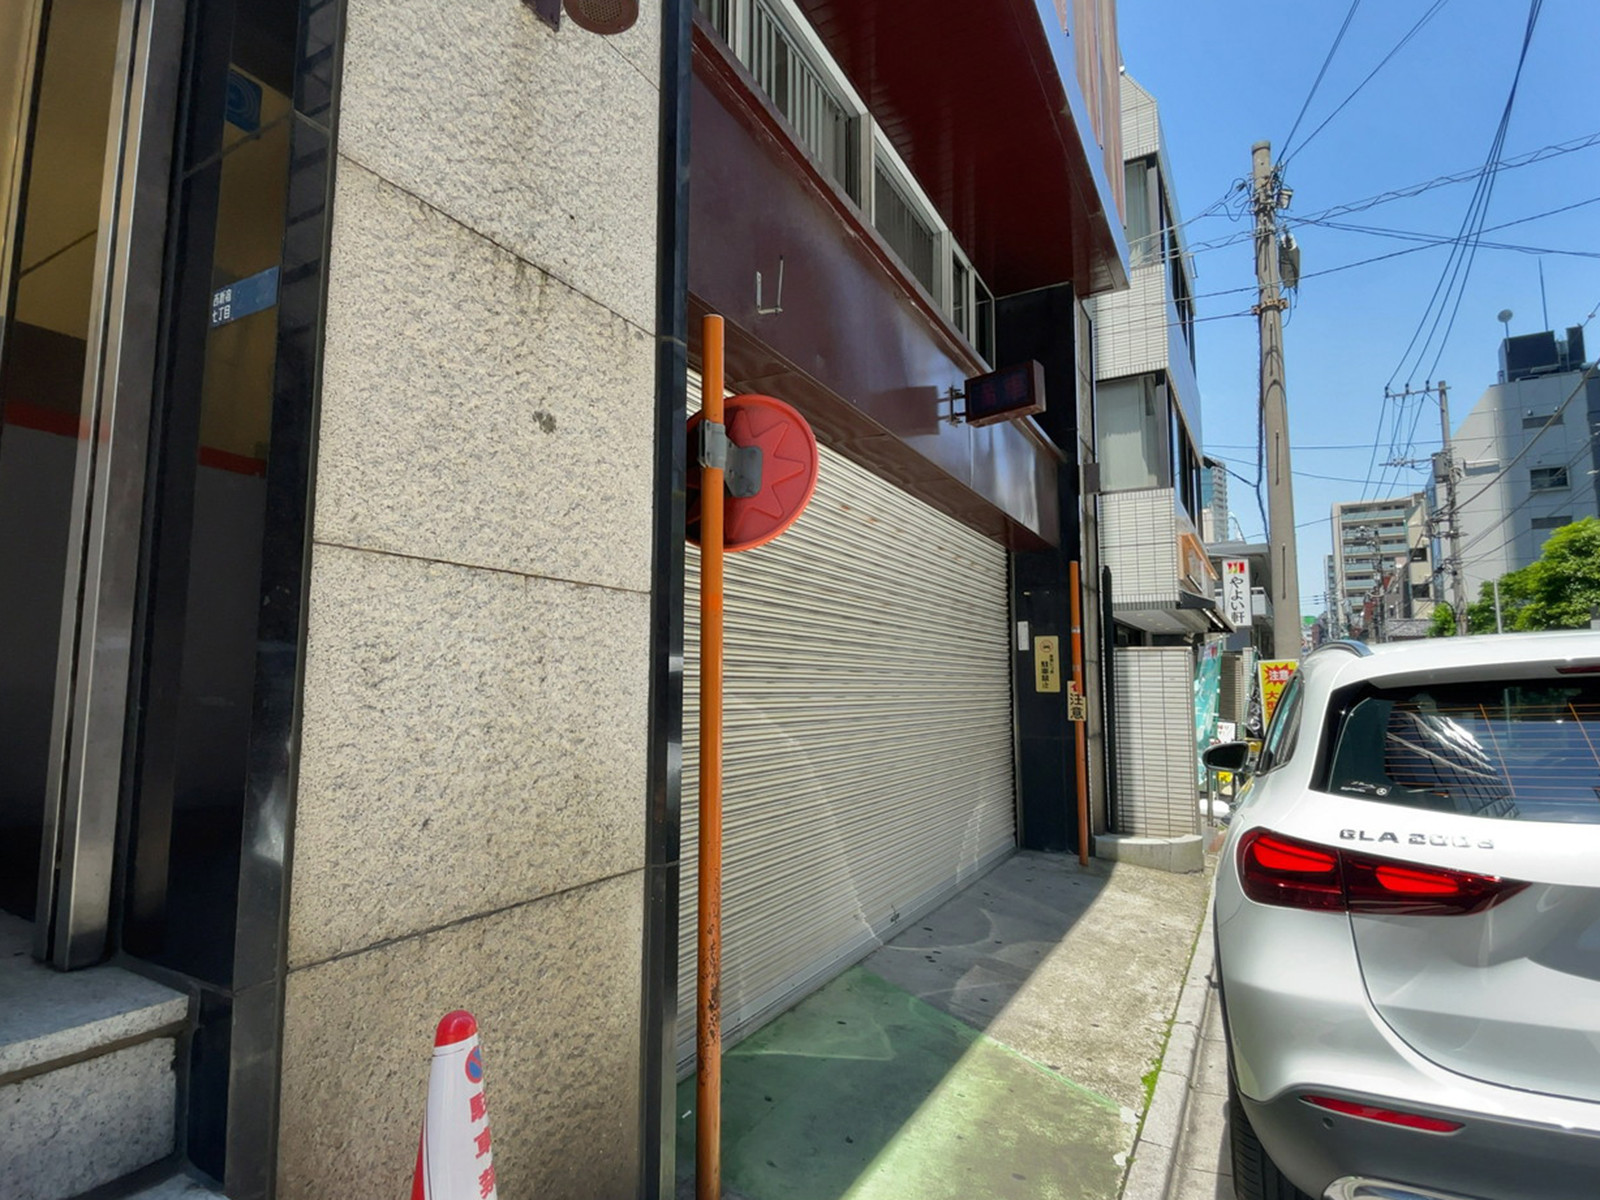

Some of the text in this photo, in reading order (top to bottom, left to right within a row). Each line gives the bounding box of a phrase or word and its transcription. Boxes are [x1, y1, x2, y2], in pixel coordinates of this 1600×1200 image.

[212, 304, 231, 323] 七丁目
[1229, 576, 1245, 624] やよい軒
[1269, 670, 1289, 681] 注意
[1070, 692, 1084, 719] 注意
[1339, 828, 1399, 844] GLA
